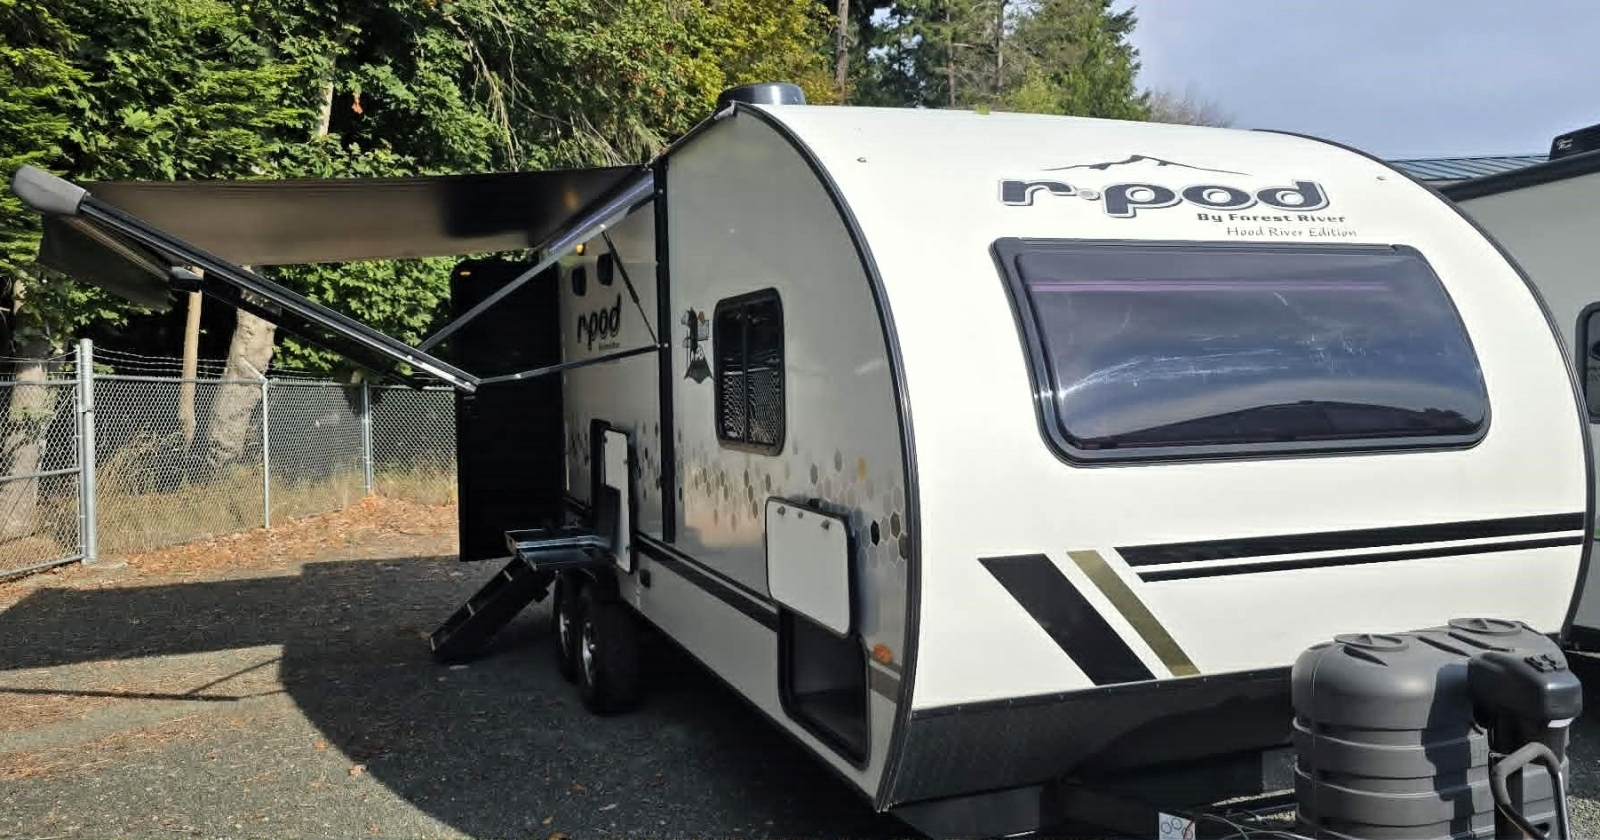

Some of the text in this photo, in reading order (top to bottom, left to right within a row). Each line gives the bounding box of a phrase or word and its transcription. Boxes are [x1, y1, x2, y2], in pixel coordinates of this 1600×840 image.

[1197, 213, 1346, 223] By Forest River
[1227, 226, 1358, 238] Hood River Edition
